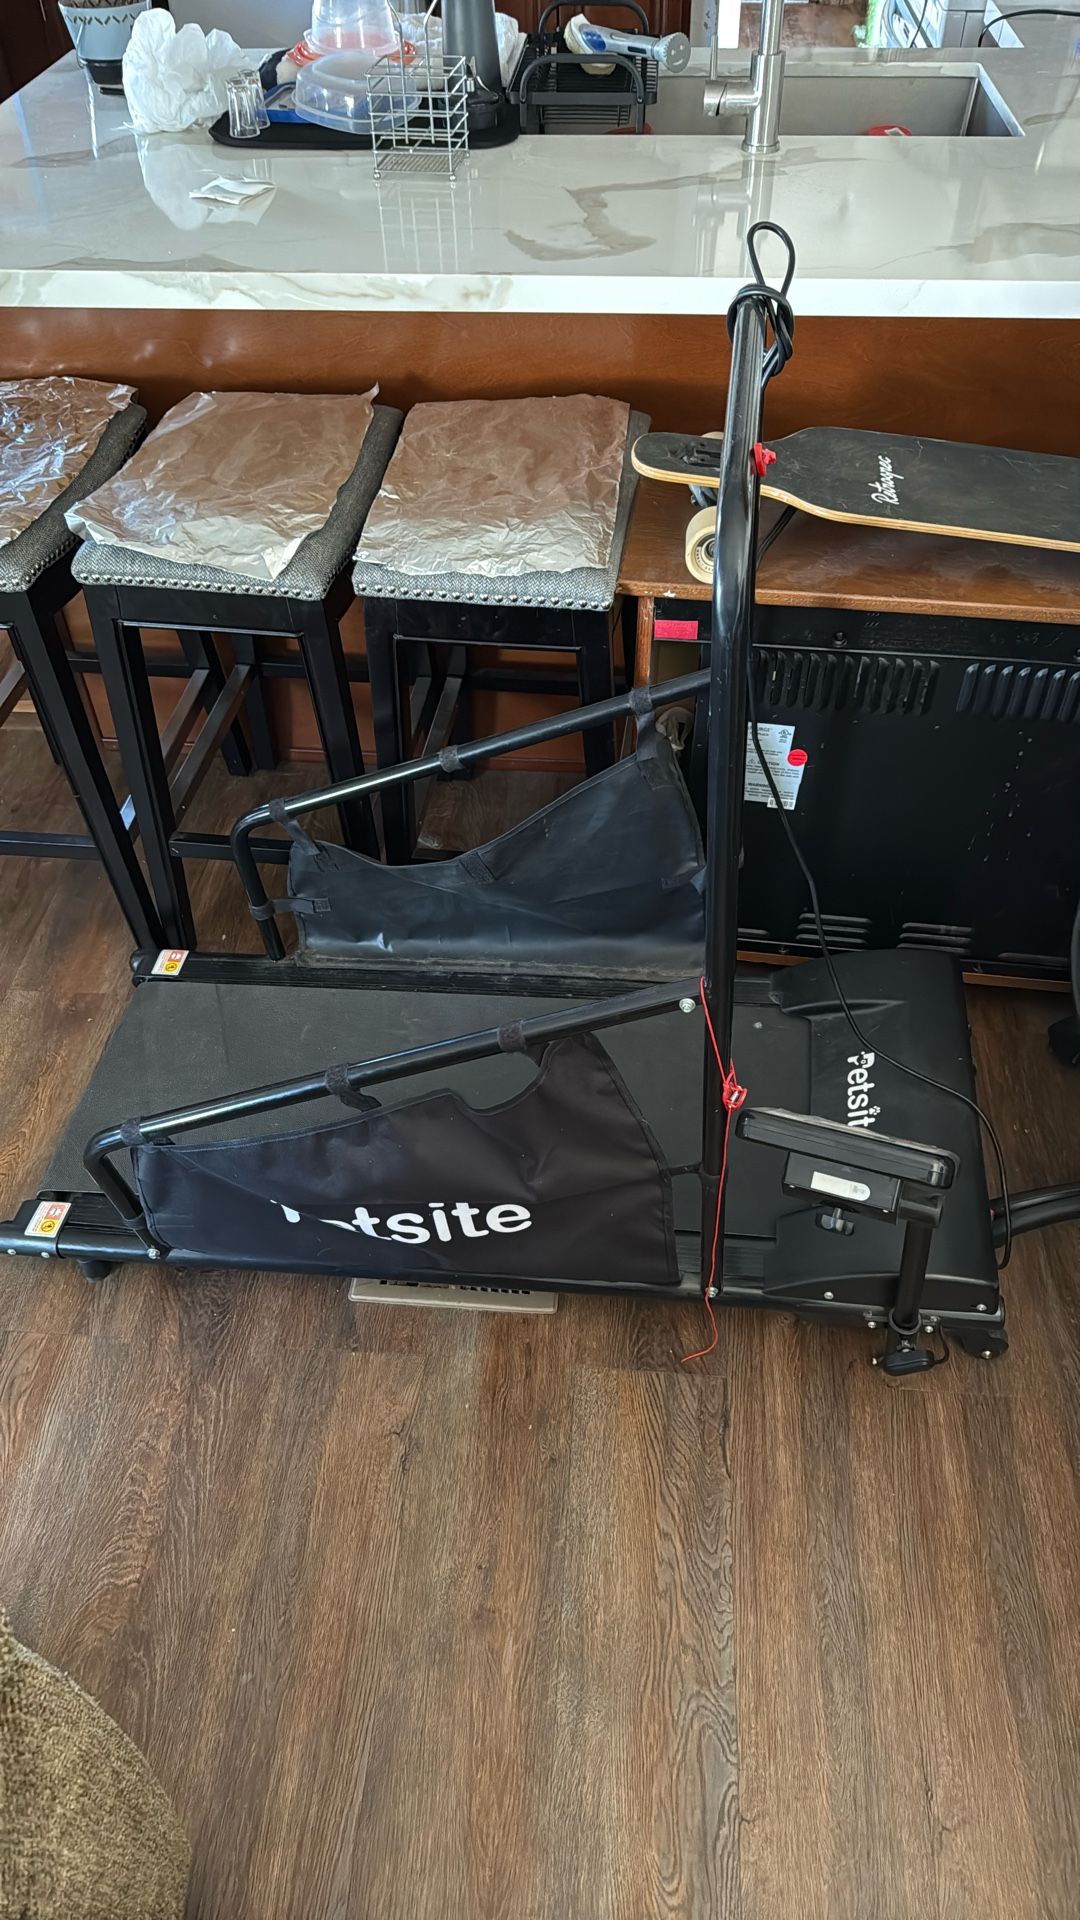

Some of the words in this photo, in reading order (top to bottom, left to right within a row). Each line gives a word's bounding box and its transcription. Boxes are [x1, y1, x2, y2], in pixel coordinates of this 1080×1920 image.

[868, 455, 905, 505] Retrospec
[847, 1051, 881, 1128] Petsit
[270, 1199, 532, 1245] tsite
